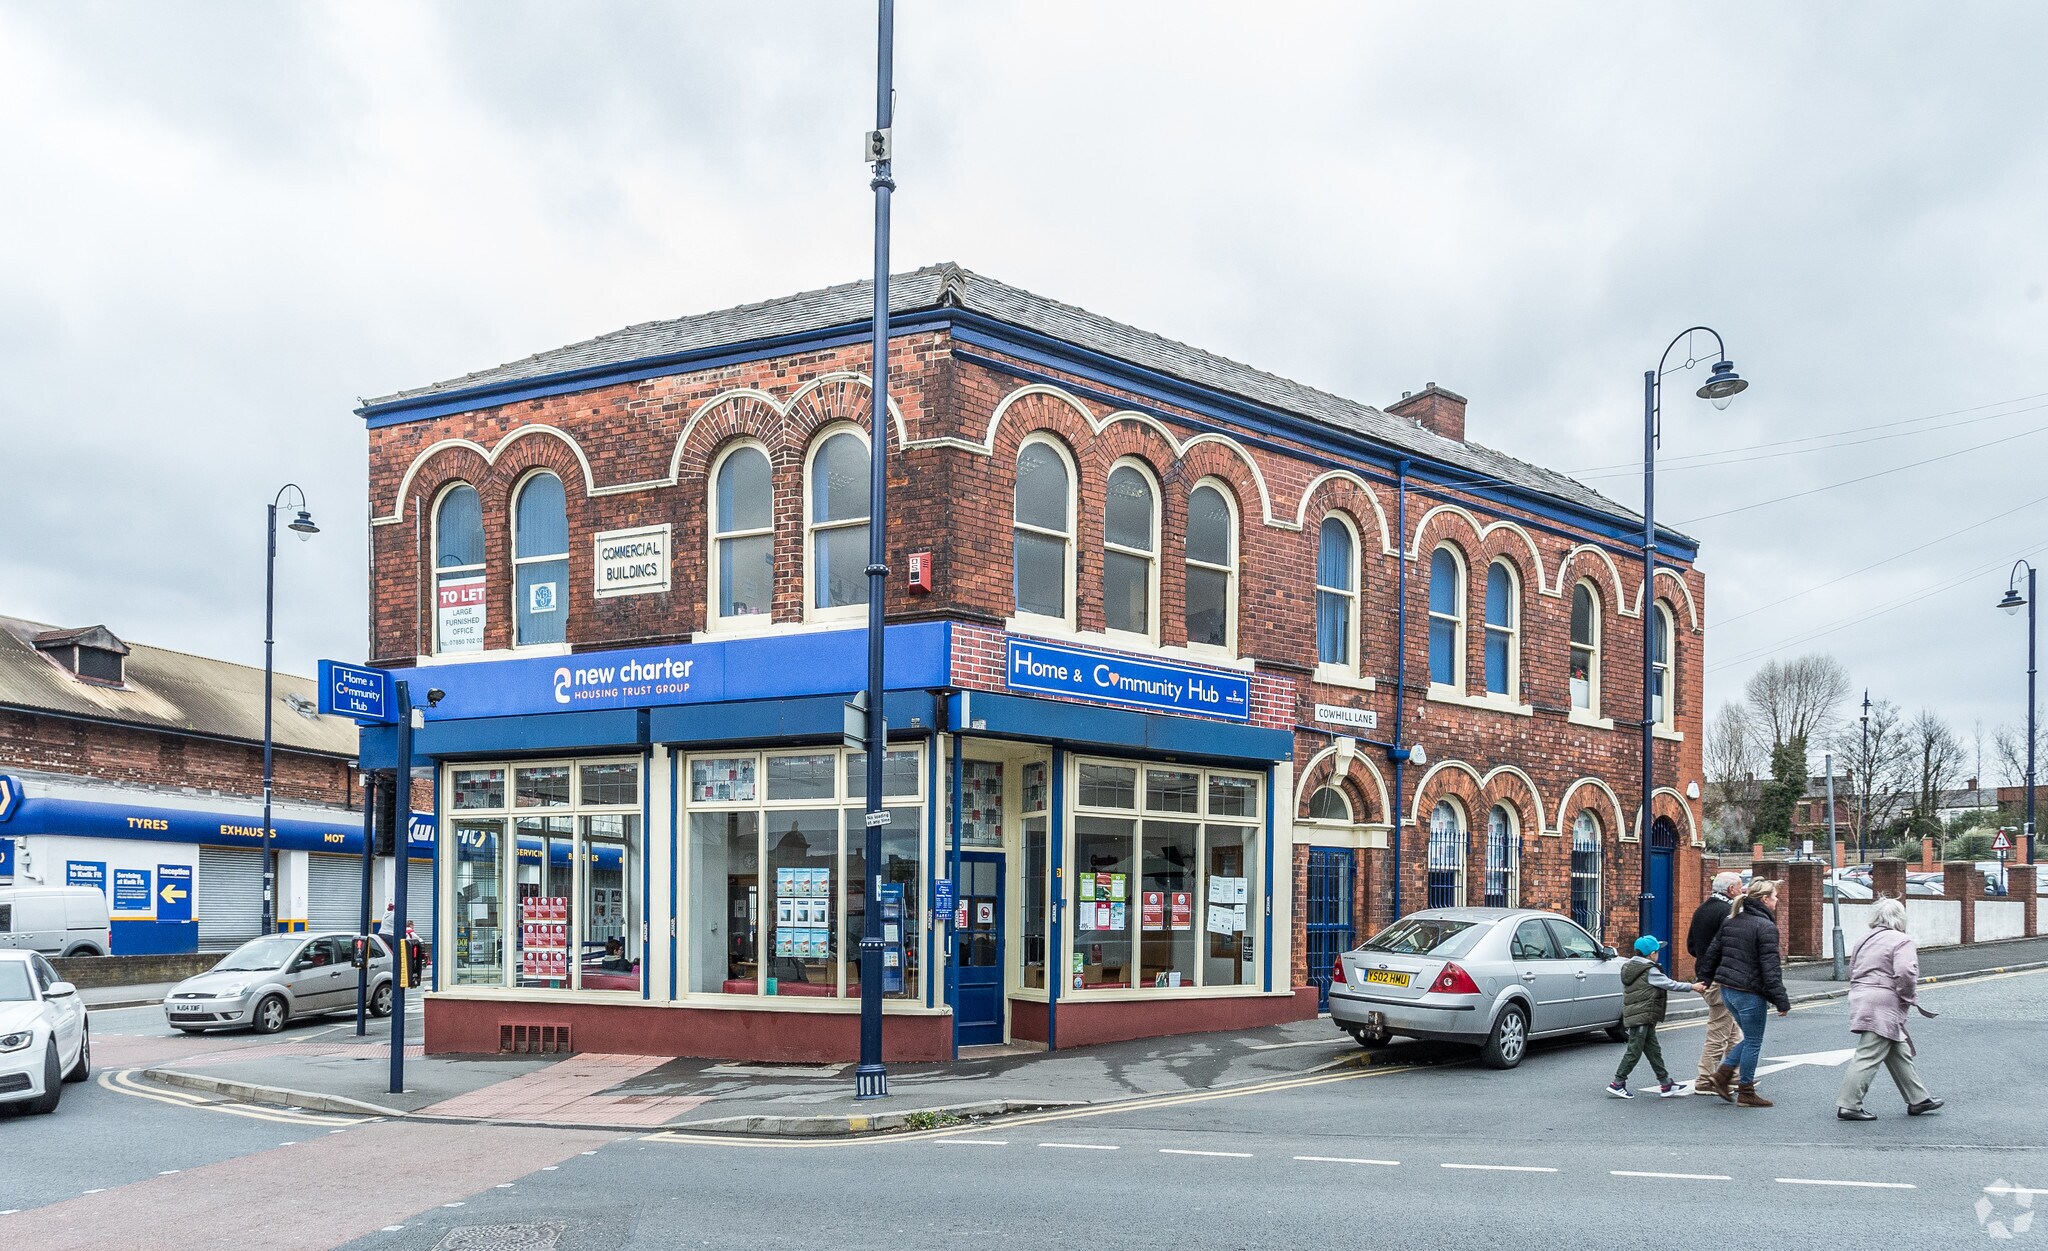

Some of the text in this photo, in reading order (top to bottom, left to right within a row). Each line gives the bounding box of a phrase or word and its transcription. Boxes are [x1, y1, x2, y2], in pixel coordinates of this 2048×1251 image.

[602, 542, 661, 560] COMMERCIAL
[440, 587, 485, 604] TO LET
[452, 607, 472, 616] LARGE
[445, 617, 479, 627] FURNISHED
[452, 627, 473, 635] OFFICE
[343, 671, 368, 686] Home
[575, 657, 693, 686] new charter
[1015, 650, 1068, 680] Home
[1073, 669, 1083, 683] &
[1188, 678, 1219, 703] Hub
[575, 683, 690, 699] HOUSING TRUST GROUP
[350, 698, 368, 711] Hub
[1319, 708, 1373, 725] COWHILL LANE
[127, 817, 168, 830] TYRES
[324, 833, 344, 843] MOT
[69, 864, 98, 872] Welcome
[77, 870, 93, 878] Kwik
[160, 867, 190, 877] Reception
[116, 872, 142, 880] Servicing
[1368, 971, 1408, 985] YS02 HMU
